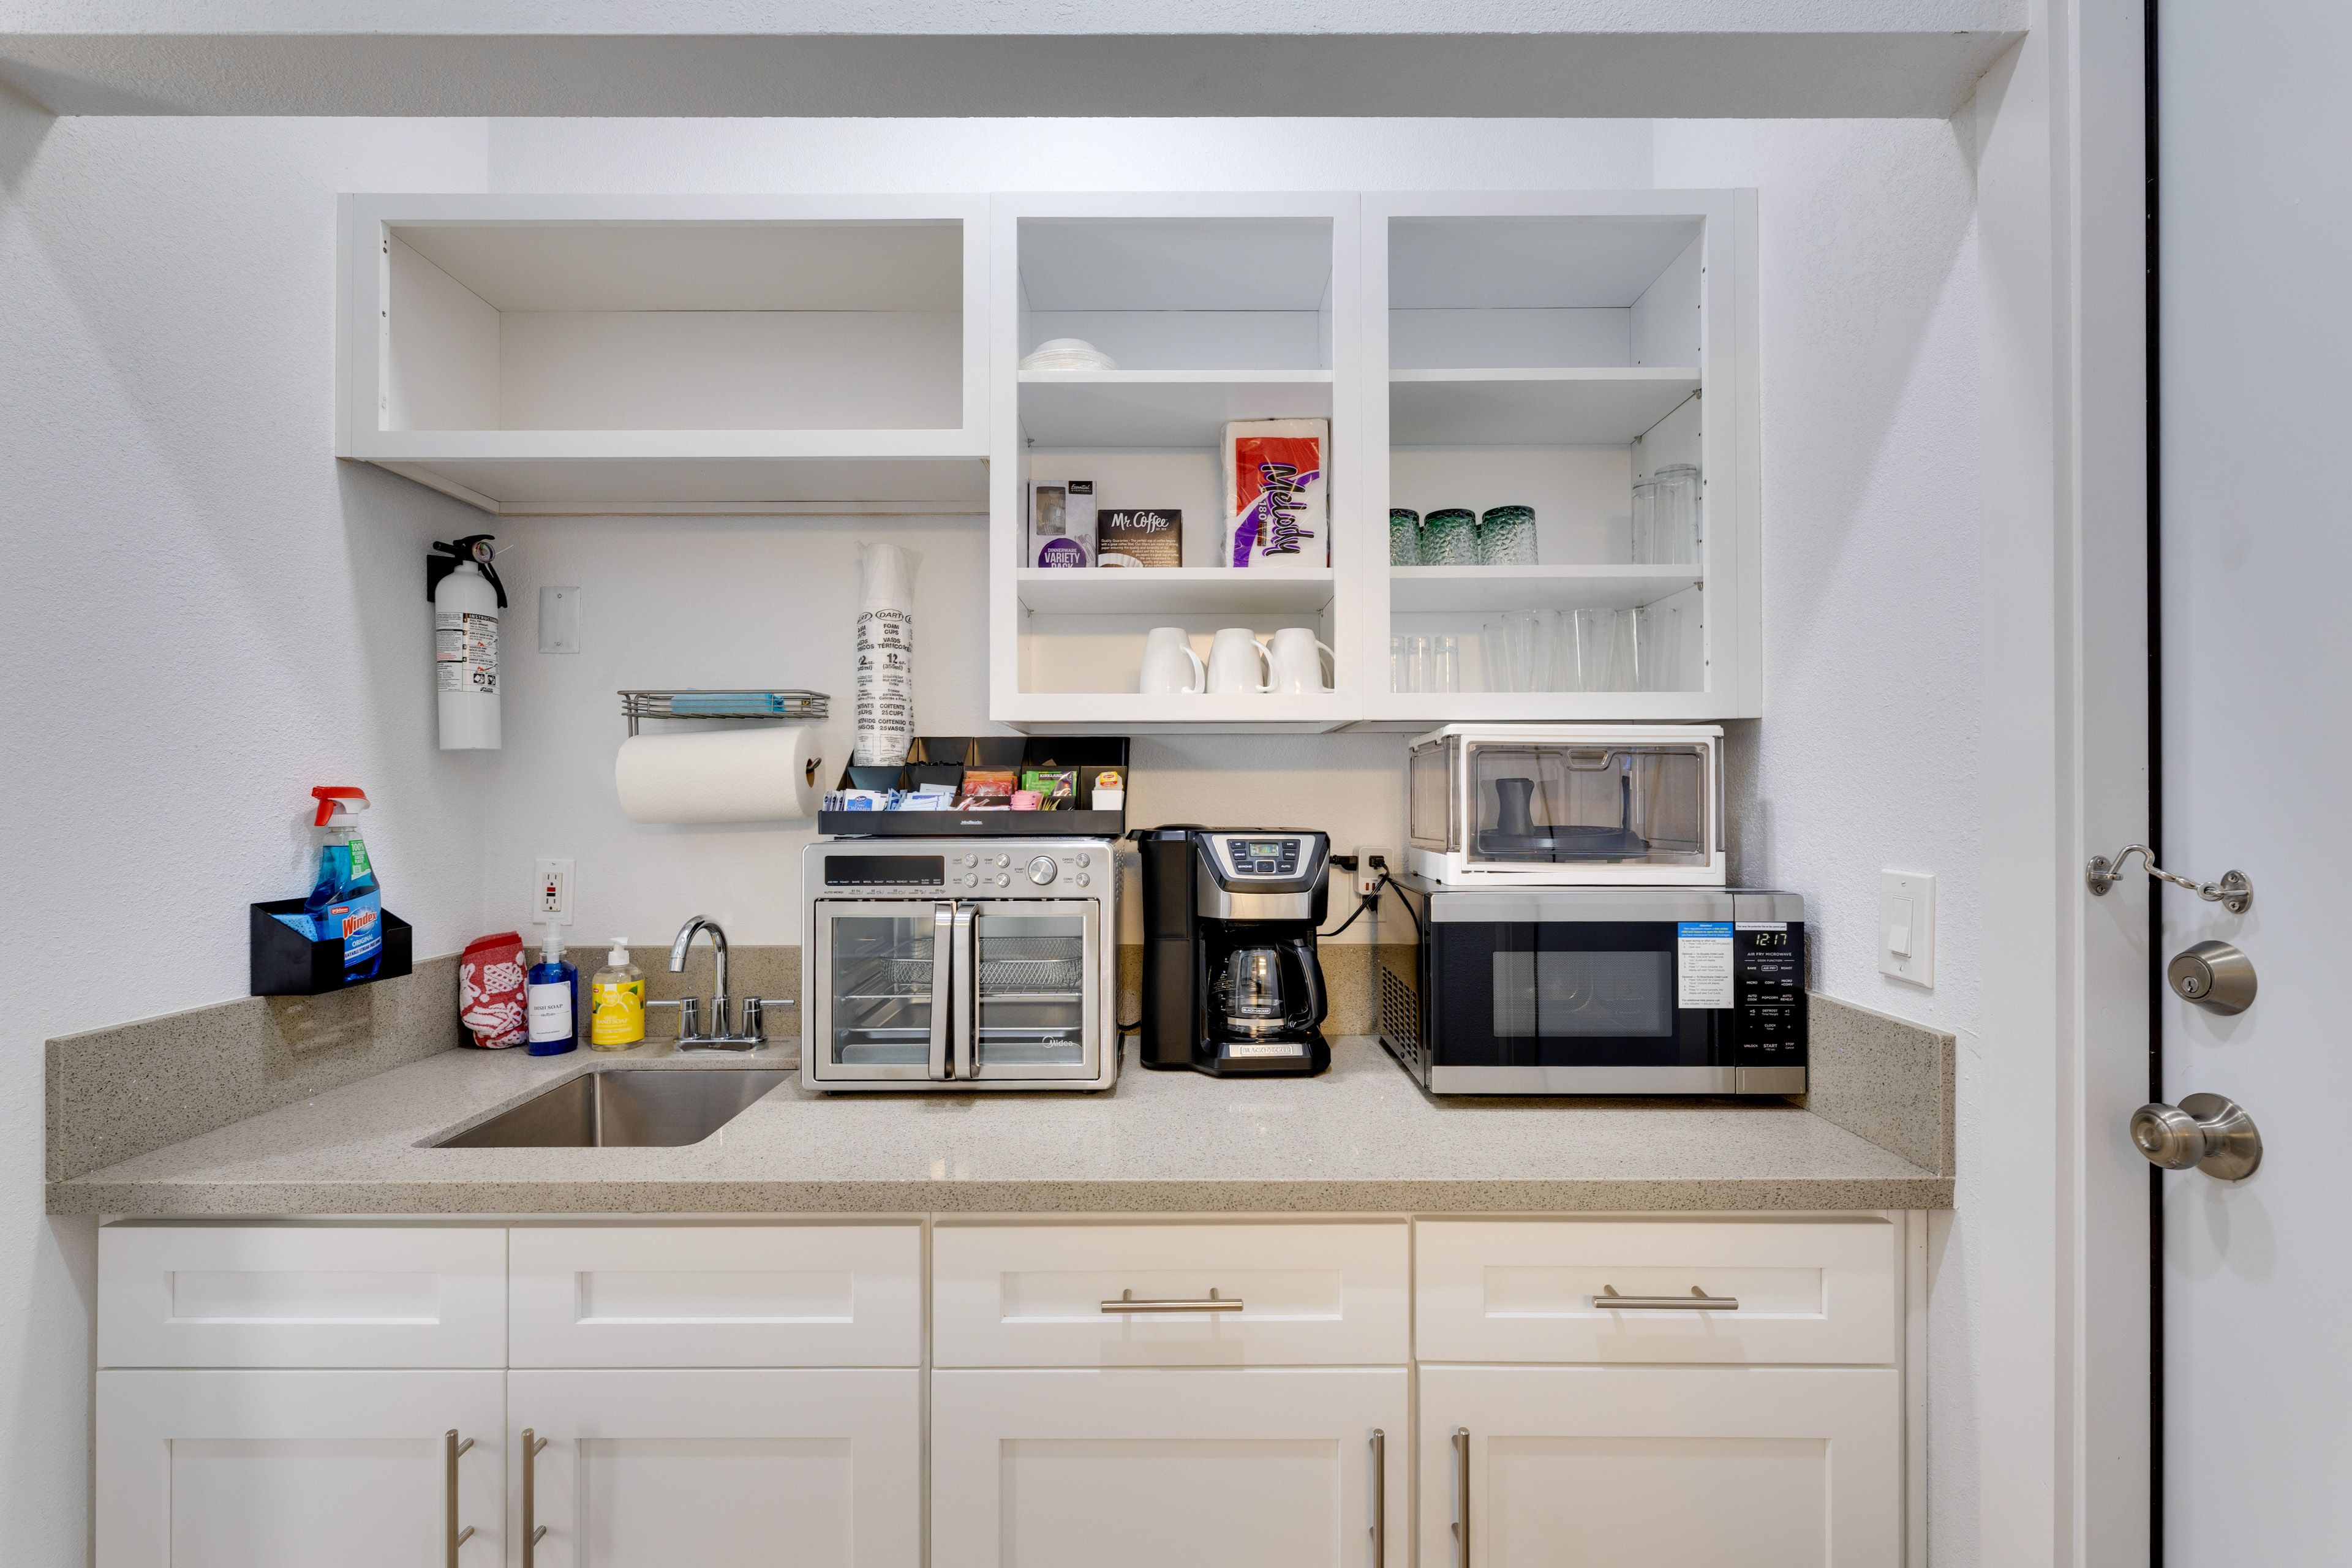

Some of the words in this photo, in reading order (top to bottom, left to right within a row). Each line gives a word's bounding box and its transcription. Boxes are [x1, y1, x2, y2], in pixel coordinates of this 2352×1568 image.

[1257, 500, 1268, 521] 180
[1259, 463, 1315, 557] Melody
[1111, 512, 1131, 530] Mr.
[1133, 511, 1169, 533] Coffee
[1044, 552, 1080, 563] VARIETY
[886, 653, 898, 664] 12
[342, 911, 377, 940] Windex
[352, 934, 373, 947] ORIGINAL
[1756, 933, 1787, 946] 12:17
